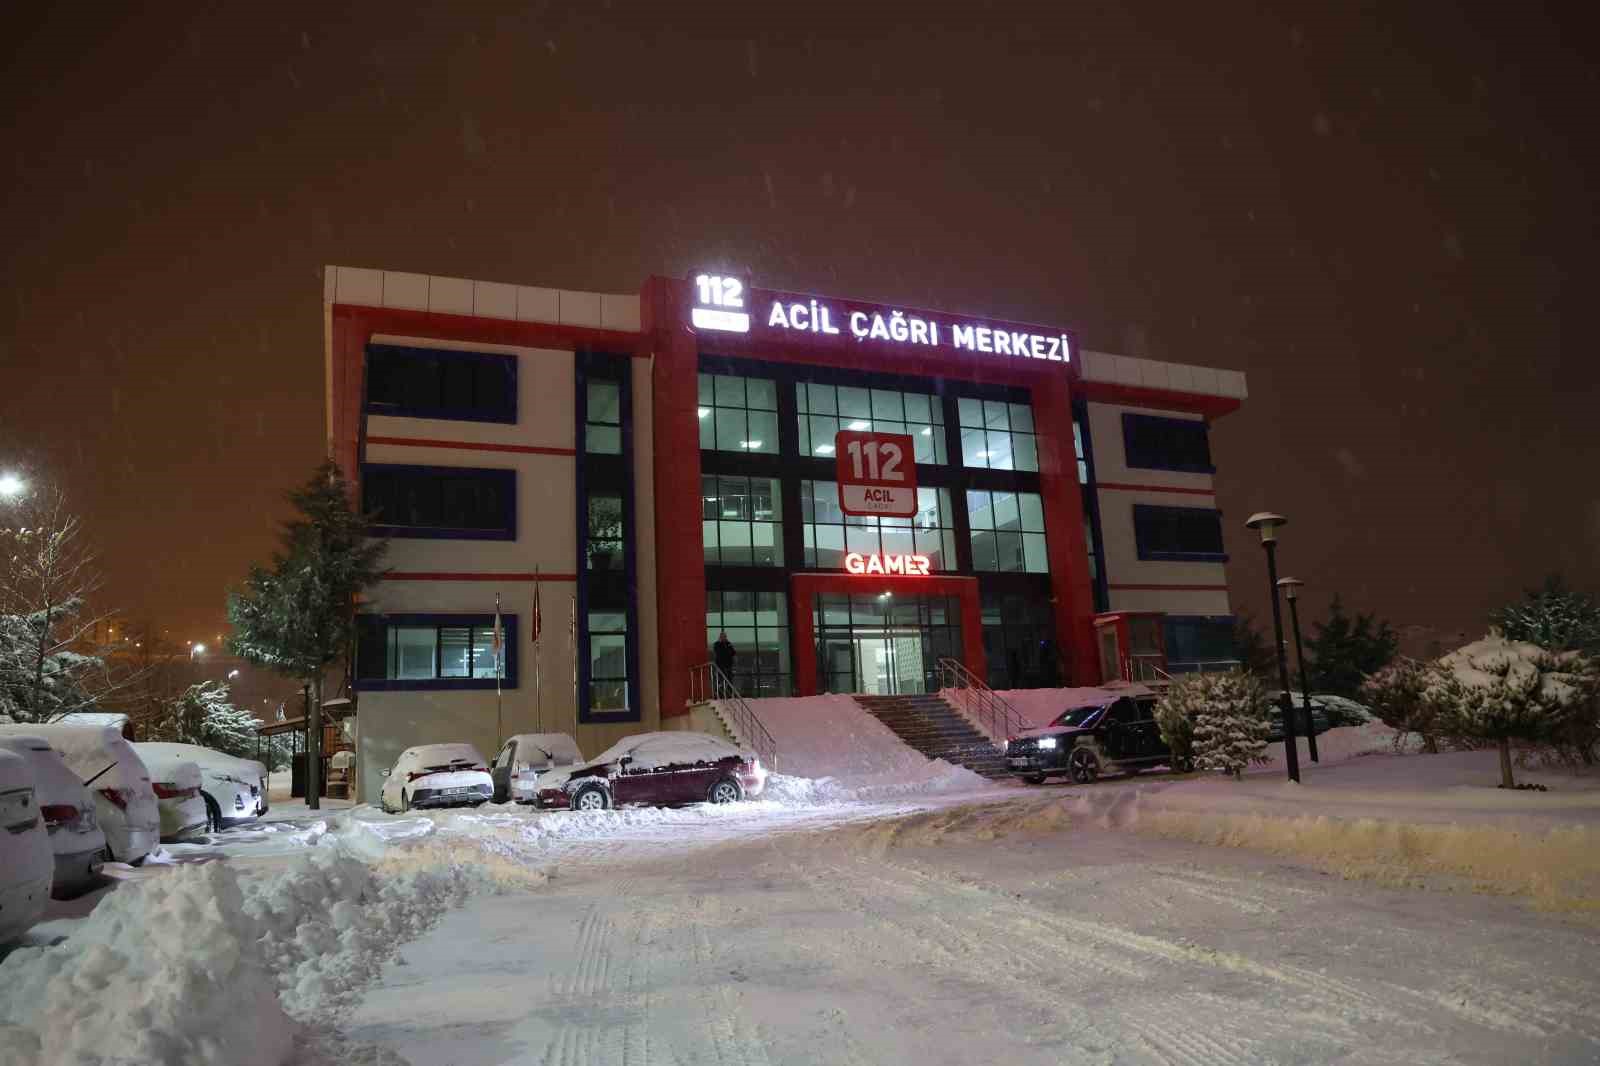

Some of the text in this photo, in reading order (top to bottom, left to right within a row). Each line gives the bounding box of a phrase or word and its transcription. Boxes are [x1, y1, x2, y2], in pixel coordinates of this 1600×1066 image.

[696, 274, 744, 307] 112
[768, 299, 1071, 363] ACİL ÇAĞRI MERKEZİ
[847, 440, 905, 481] 112
[845, 552, 930, 575] GAMER
